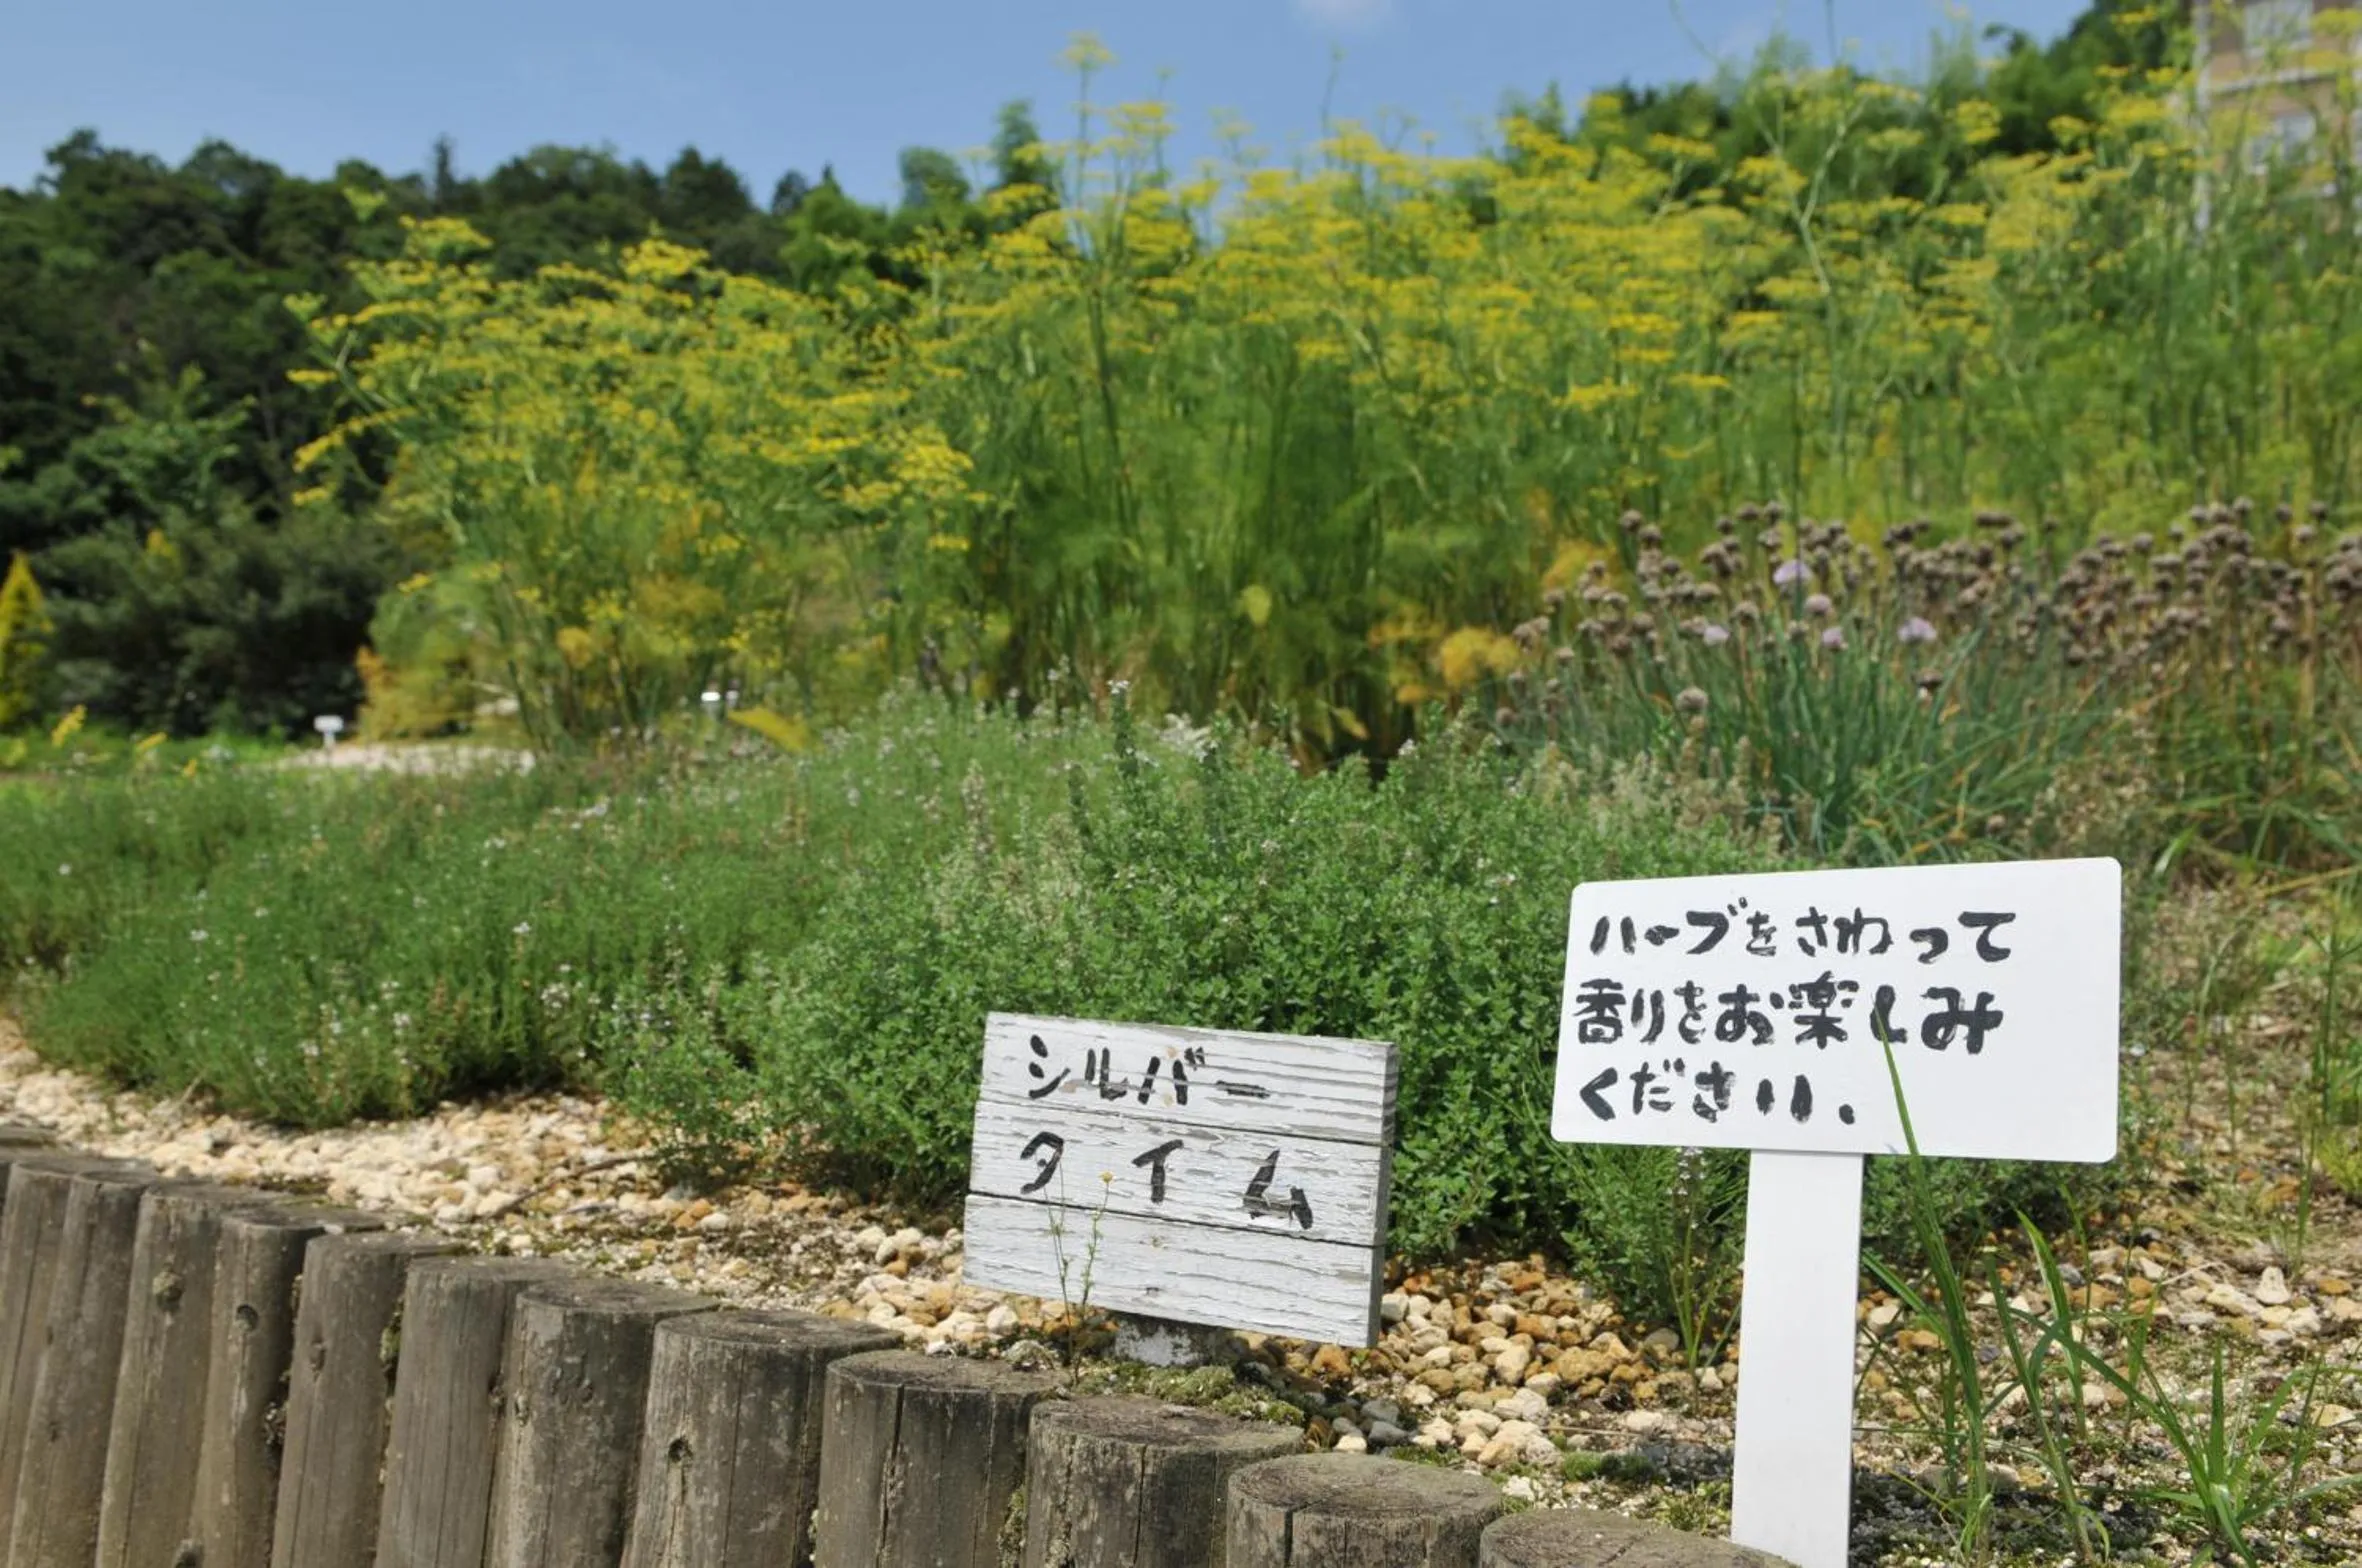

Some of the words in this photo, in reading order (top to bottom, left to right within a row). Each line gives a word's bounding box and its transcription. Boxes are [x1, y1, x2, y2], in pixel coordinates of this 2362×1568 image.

[1589, 896, 2017, 964] ハーブをさわって
[1574, 971, 2004, 1055] 香りをお楽しみ
[1029, 1034, 1271, 1106] シルバー
[1020, 1130, 1313, 1230] タイム
